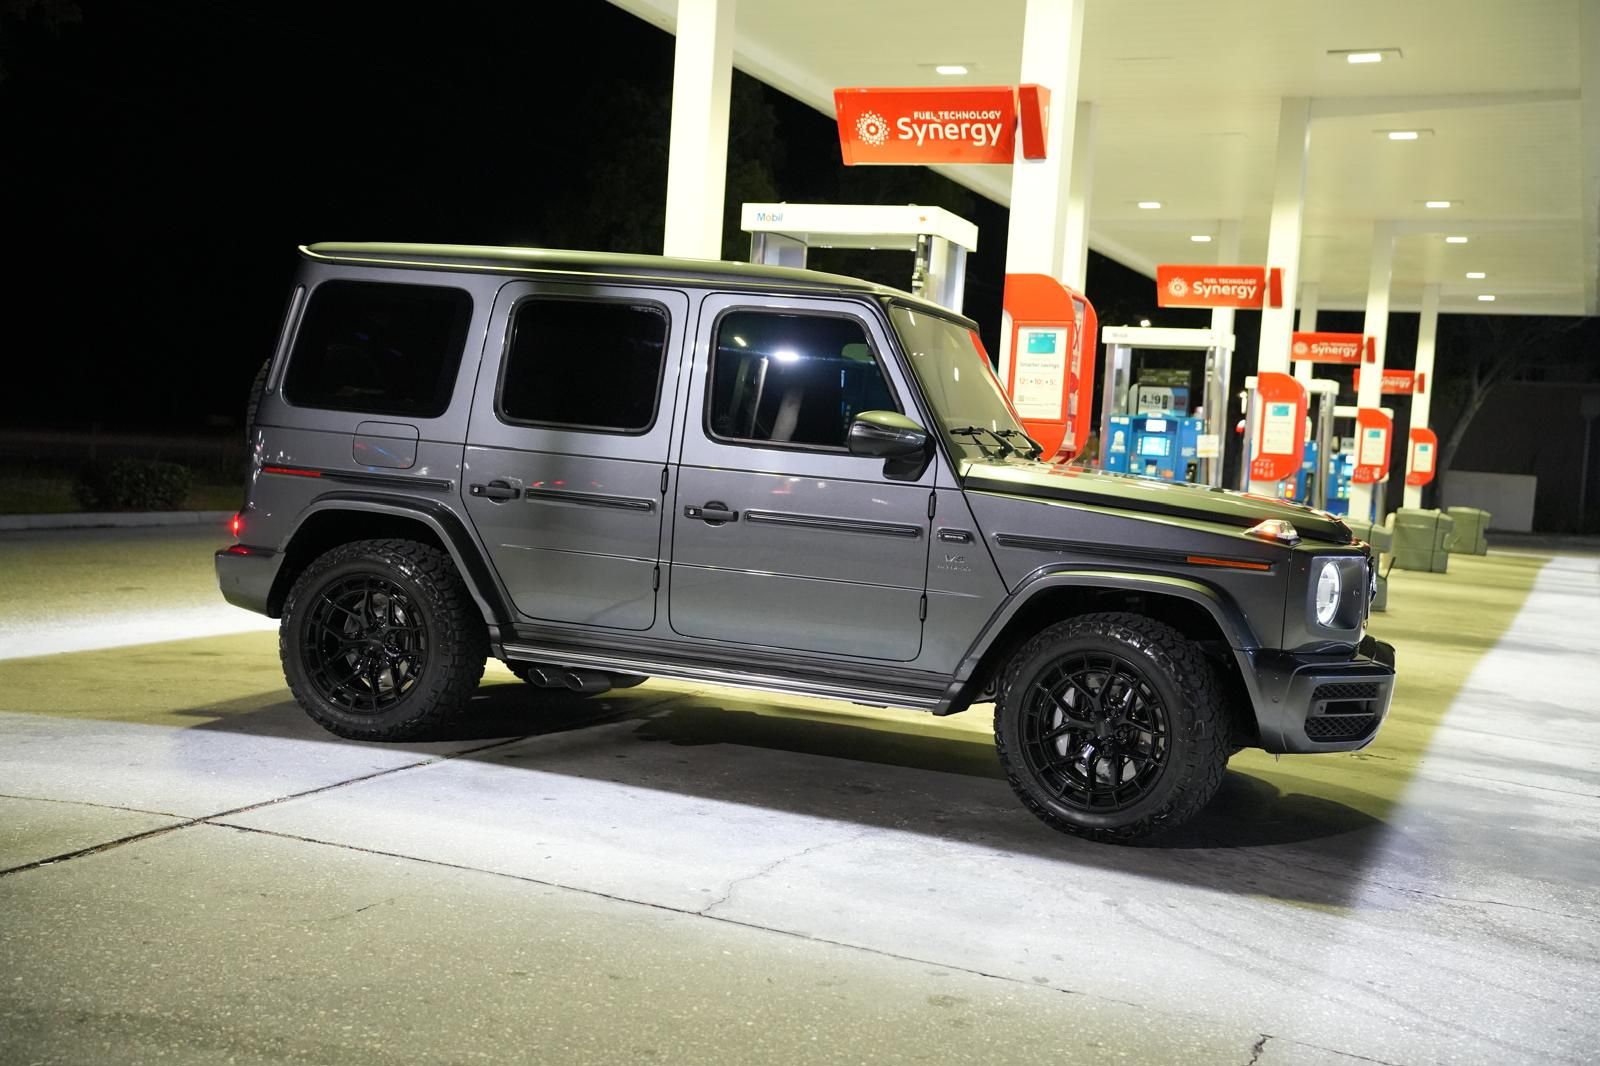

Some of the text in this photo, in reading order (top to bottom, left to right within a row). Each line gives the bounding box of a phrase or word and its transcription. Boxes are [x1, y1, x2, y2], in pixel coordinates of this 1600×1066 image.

[914, 110, 1001, 120] FUEL TECHNOLOGY
[896, 117, 1002, 146] Synergy
[757, 212, 783, 222] Mobil
[1192, 281, 1257, 300] Synergy
[1310, 344, 1357, 358] Synergy
[1381, 377, 1410, 389] ynergy
